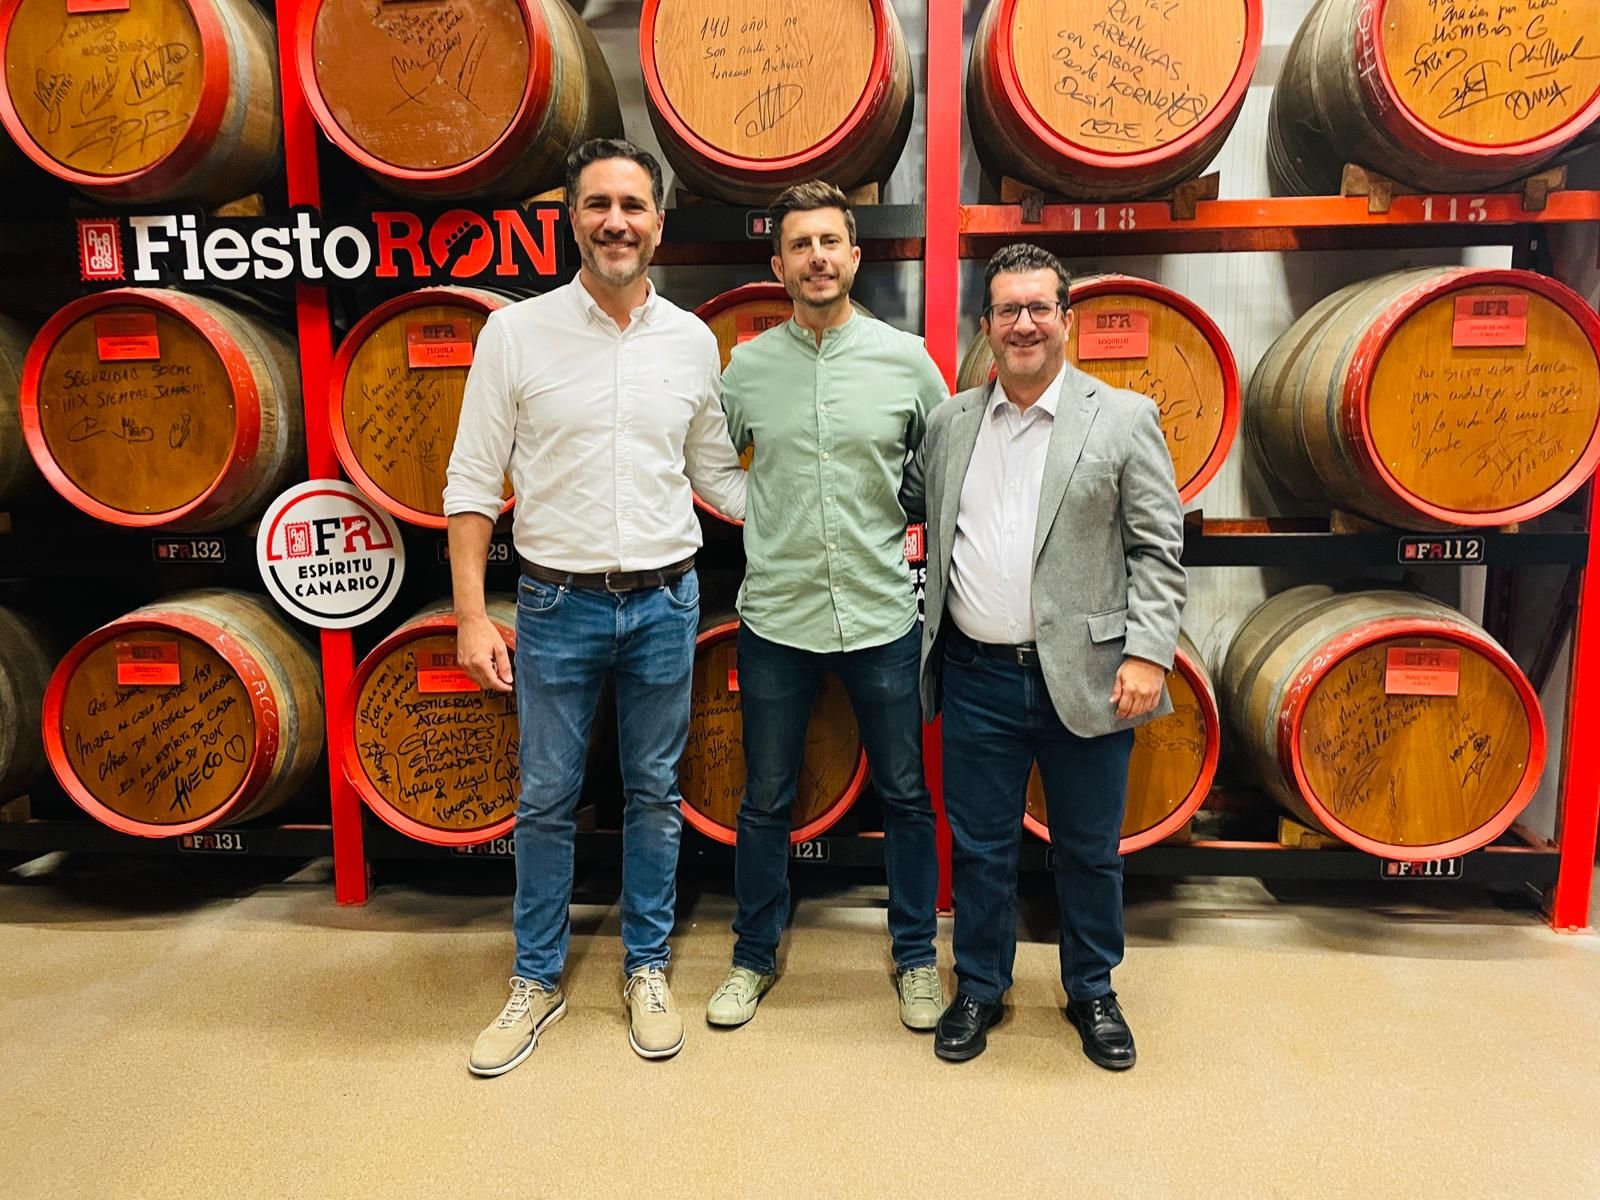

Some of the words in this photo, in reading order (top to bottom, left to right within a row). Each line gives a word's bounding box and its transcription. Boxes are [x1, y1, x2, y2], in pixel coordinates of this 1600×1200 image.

[701, 16, 730, 40] 140
[1091, 45, 1144, 82] SABOR
[1071, 207, 1136, 231] 118
[298, 558, 372, 579] ESPÍRITU
[295, 575, 379, 597] CANARIO
